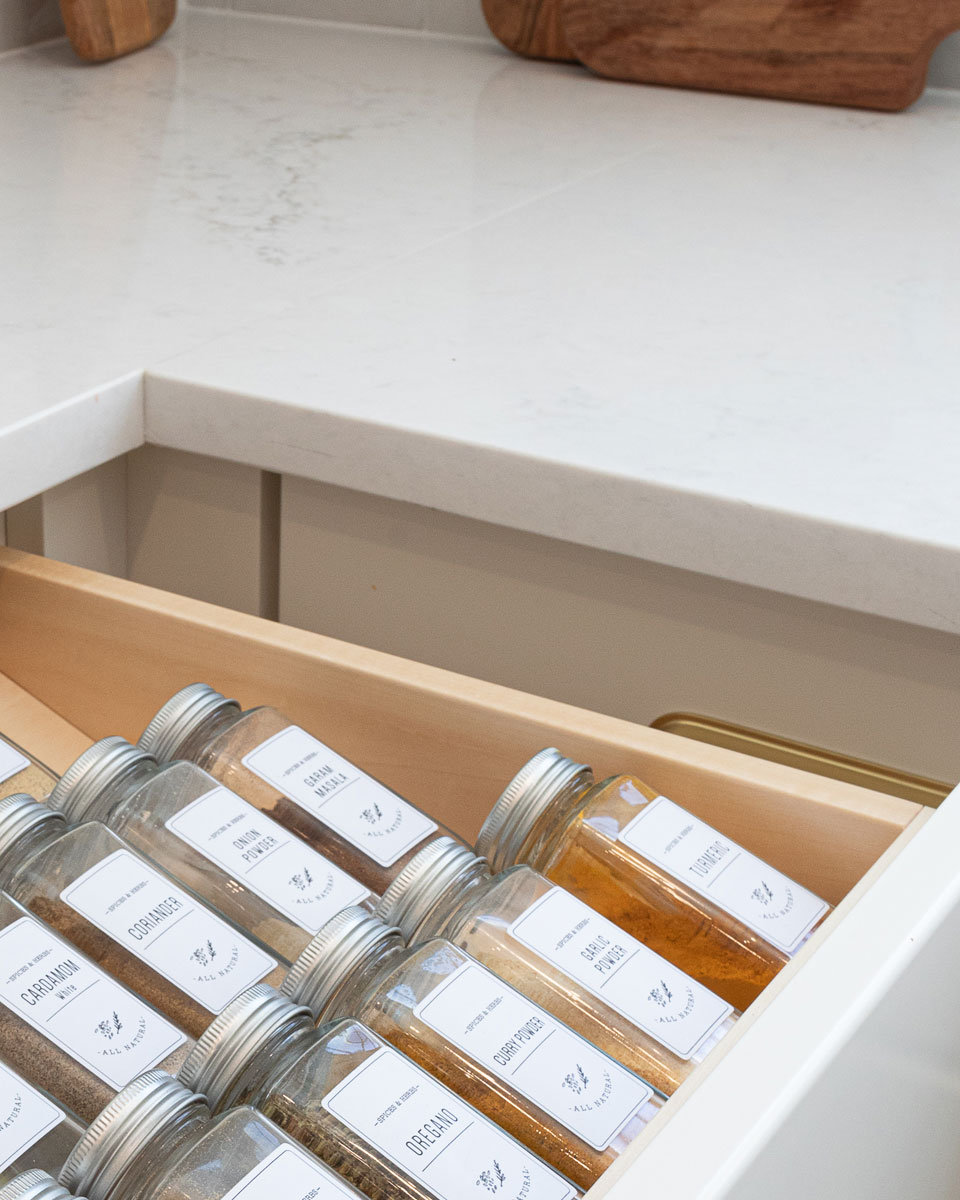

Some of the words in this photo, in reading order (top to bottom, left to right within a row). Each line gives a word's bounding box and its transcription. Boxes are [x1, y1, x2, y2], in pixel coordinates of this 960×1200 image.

[304, 765, 333, 787] GARAM
[314, 773, 347, 798] MASALA
[232, 829, 261, 850] ONION
[241, 836, 278, 863] POWDER
[689, 841, 730, 877] TURMERIC
[128, 897, 183, 940] CORIANDER
[580, 935, 610, 961] GARLIC
[594, 945, 627, 974] POWDER
[20, 959, 80, 1006] CARDAMOM
[493, 1038, 522, 1066] CURRY
[514, 1016, 545, 1044] POWDER
[405, 1108, 458, 1156] OREGANO
